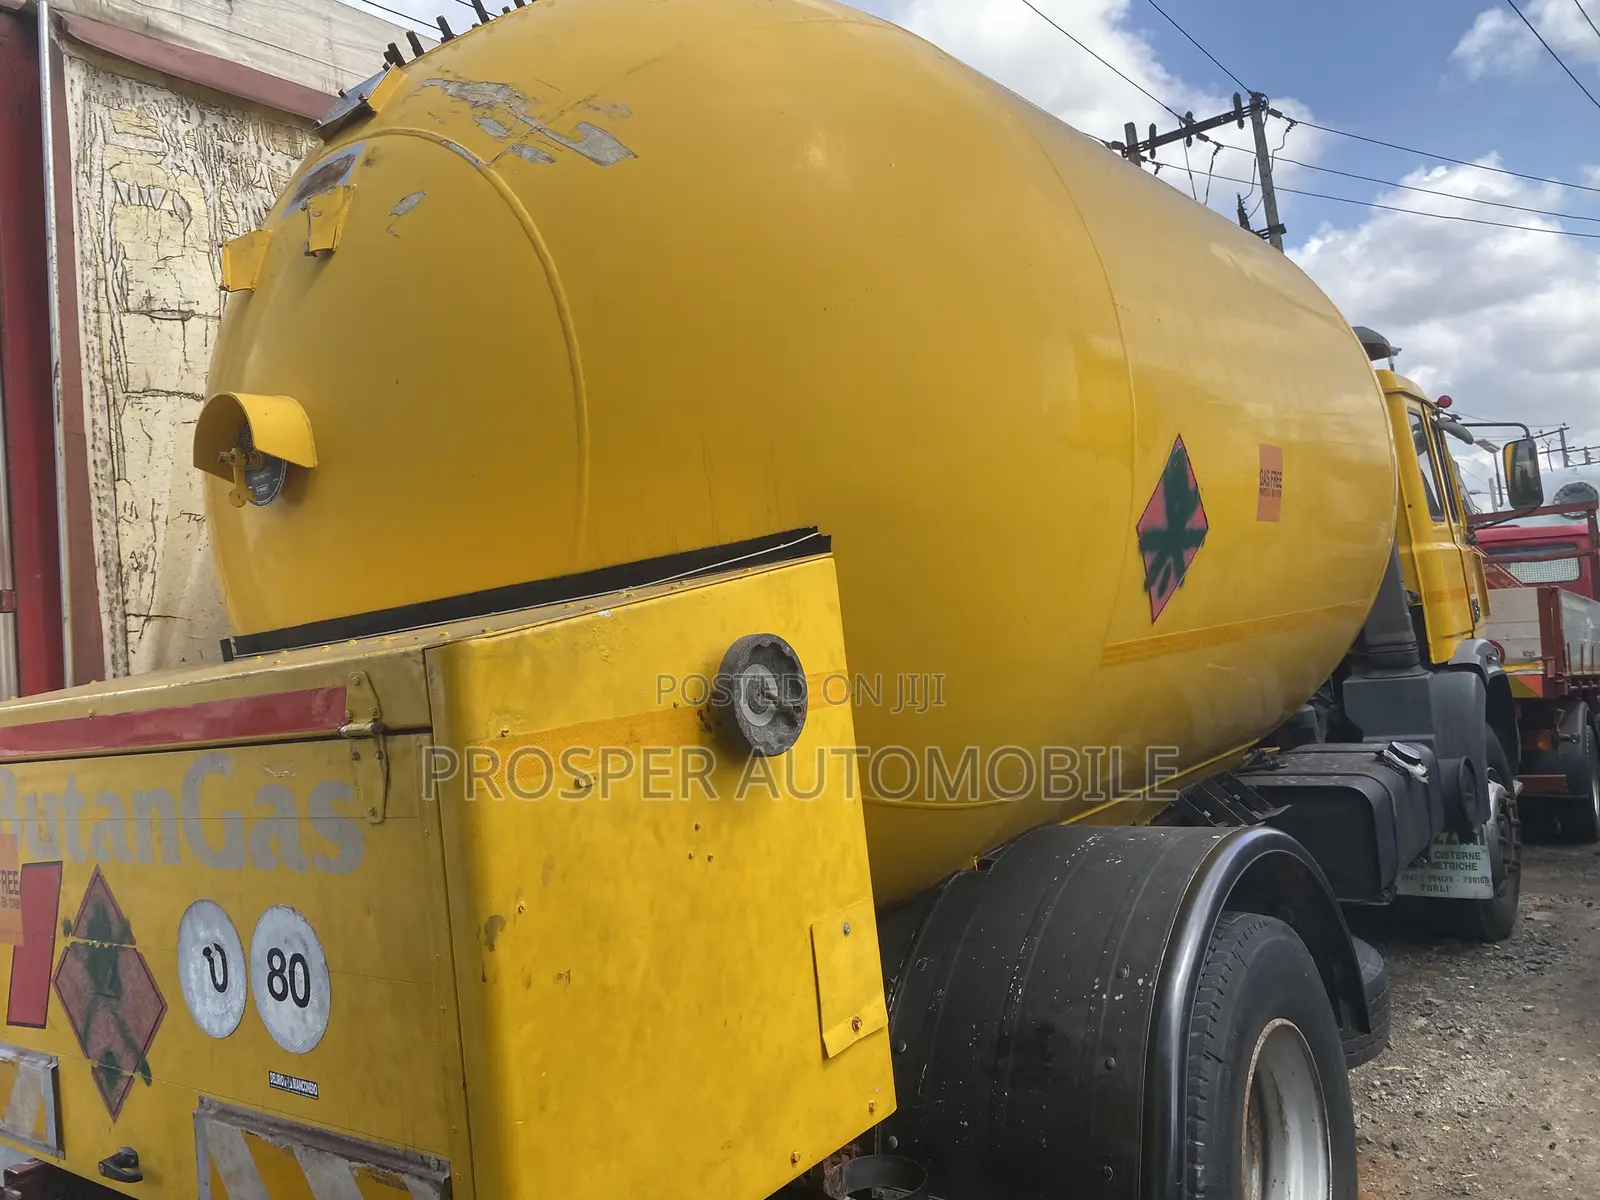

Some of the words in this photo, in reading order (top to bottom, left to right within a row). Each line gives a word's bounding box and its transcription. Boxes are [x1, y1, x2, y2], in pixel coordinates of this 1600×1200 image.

[1260, 468, 1270, 487] GAS
[1271, 470, 1283, 489] FREE
[1434, 851, 1481, 861] CISTERNE
[0, 869, 19, 895] REE
[267, 947, 311, 1008] 80
